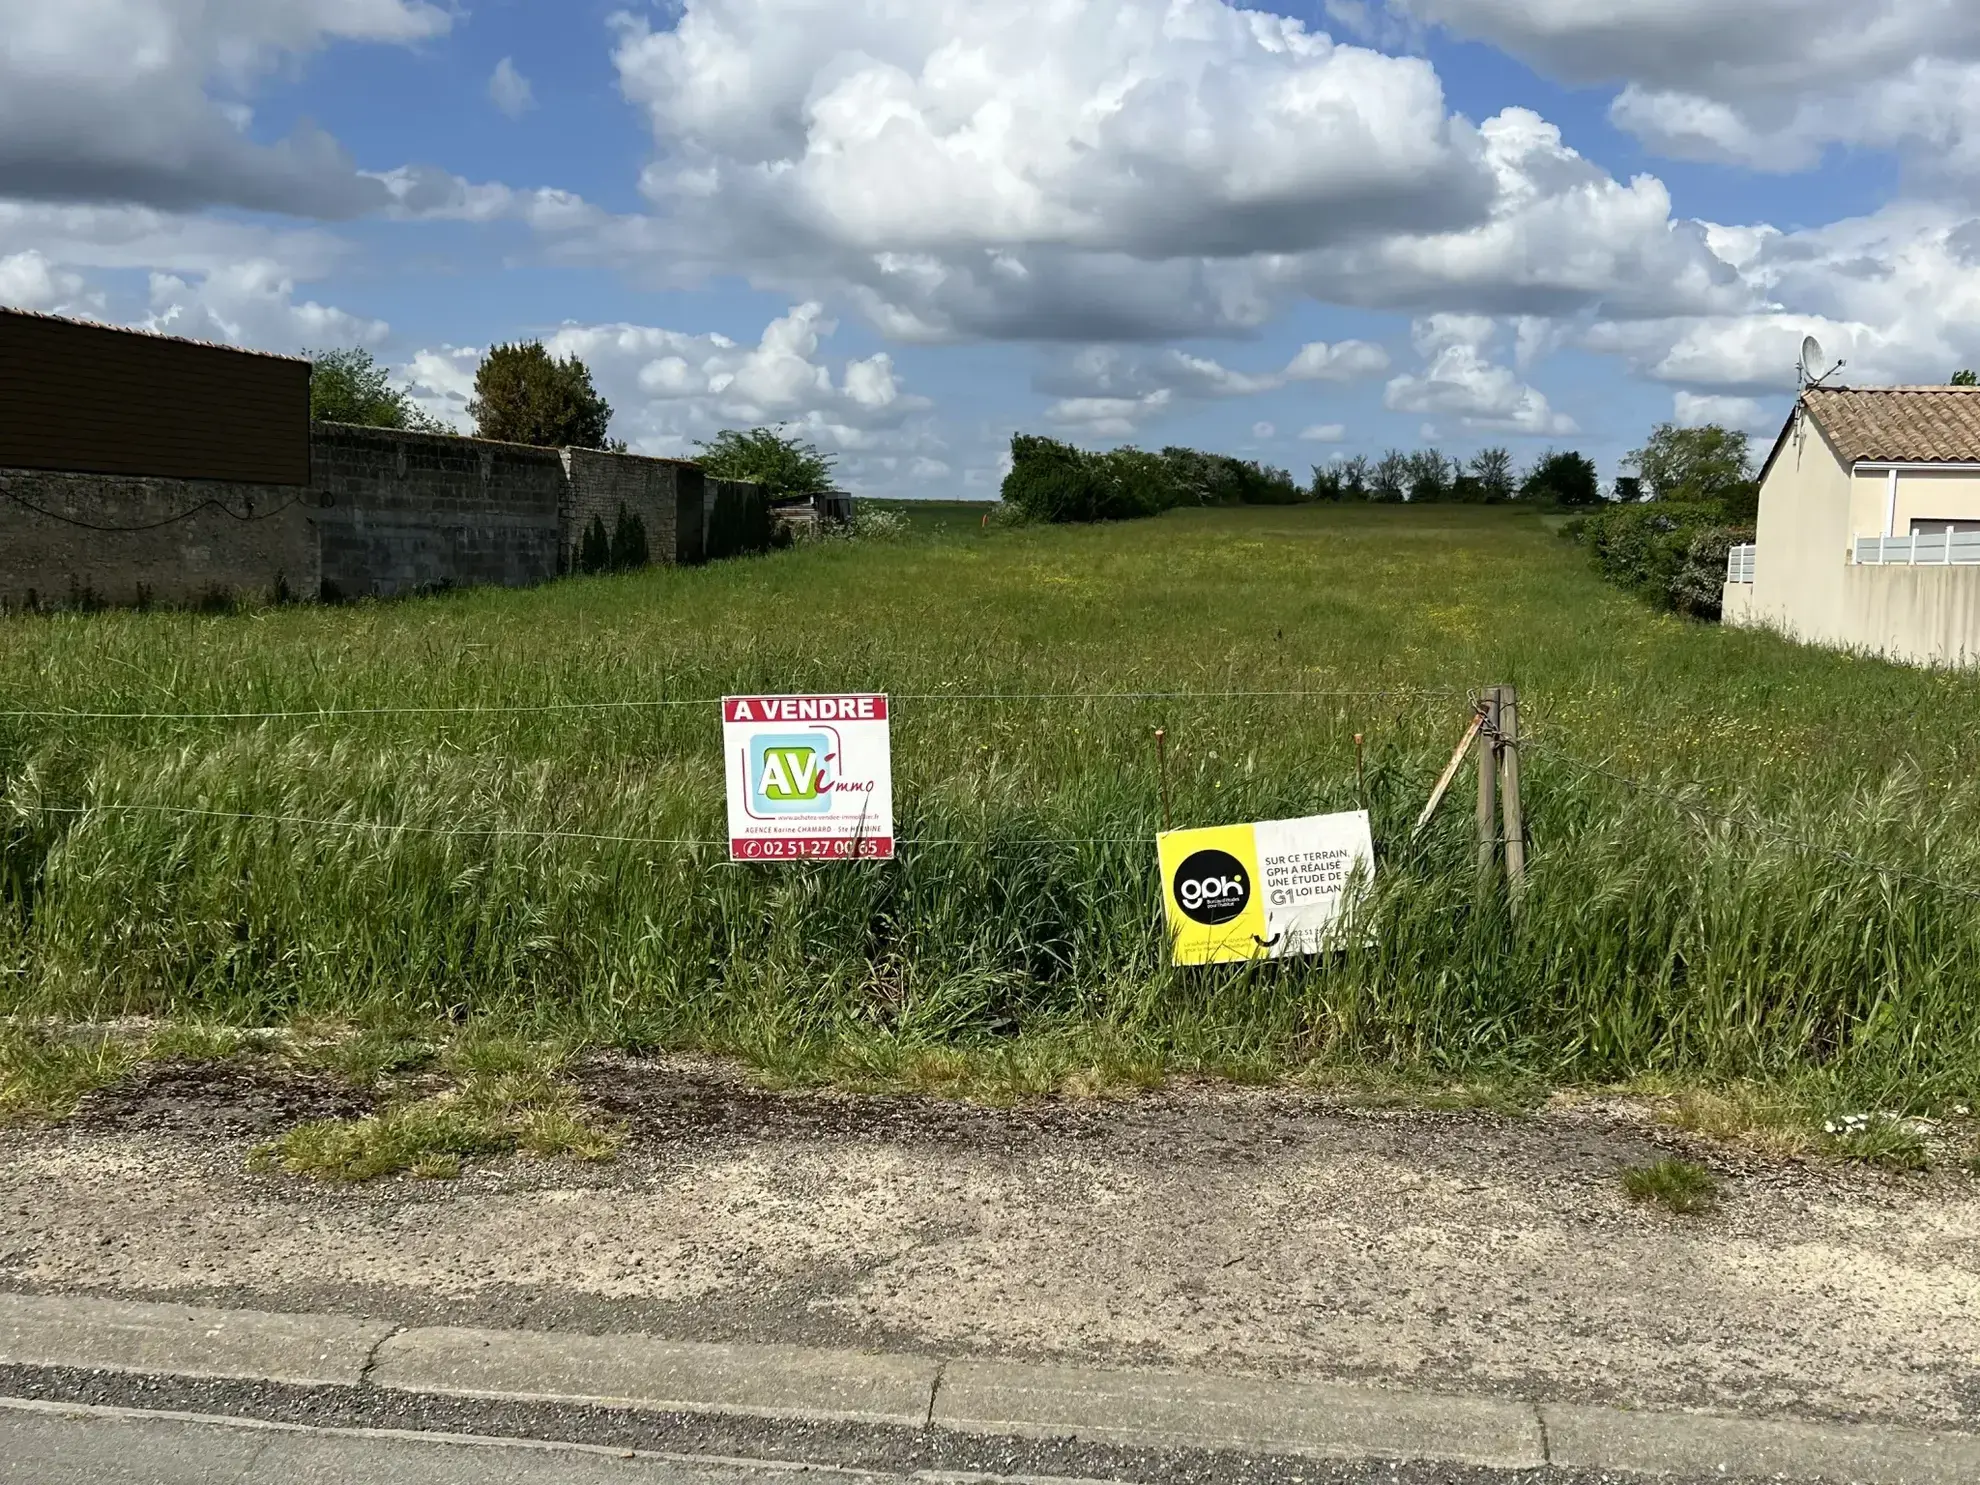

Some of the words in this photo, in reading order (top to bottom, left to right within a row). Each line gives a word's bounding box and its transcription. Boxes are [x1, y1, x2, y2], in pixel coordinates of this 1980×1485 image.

[734, 700, 754, 720] A
[760, 698, 875, 720] VENDRE
[797, 825, 832, 833] CHAMARD
[763, 841, 784, 856] 02
[787, 840, 806, 855] 51
[810, 840, 831, 855] 27
[858, 840, 878, 854] 65
[1265, 856, 1286, 866] SUR
[1288, 854, 1301, 863] CE
[1266, 867, 1289, 877] GPH
[1291, 866, 1299, 874] A
[1301, 861, 1341, 873] RÉALISÉ
[1267, 878, 1289, 887] UNE
[1292, 873, 1325, 885] ÉTUDE
[1328, 871, 1342, 881] DE
[1180, 875, 1244, 909] gph
[1270, 888, 1295, 906] G1
[1295, 887, 1312, 896] LOI
[1315, 884, 1342, 894] ELAN
